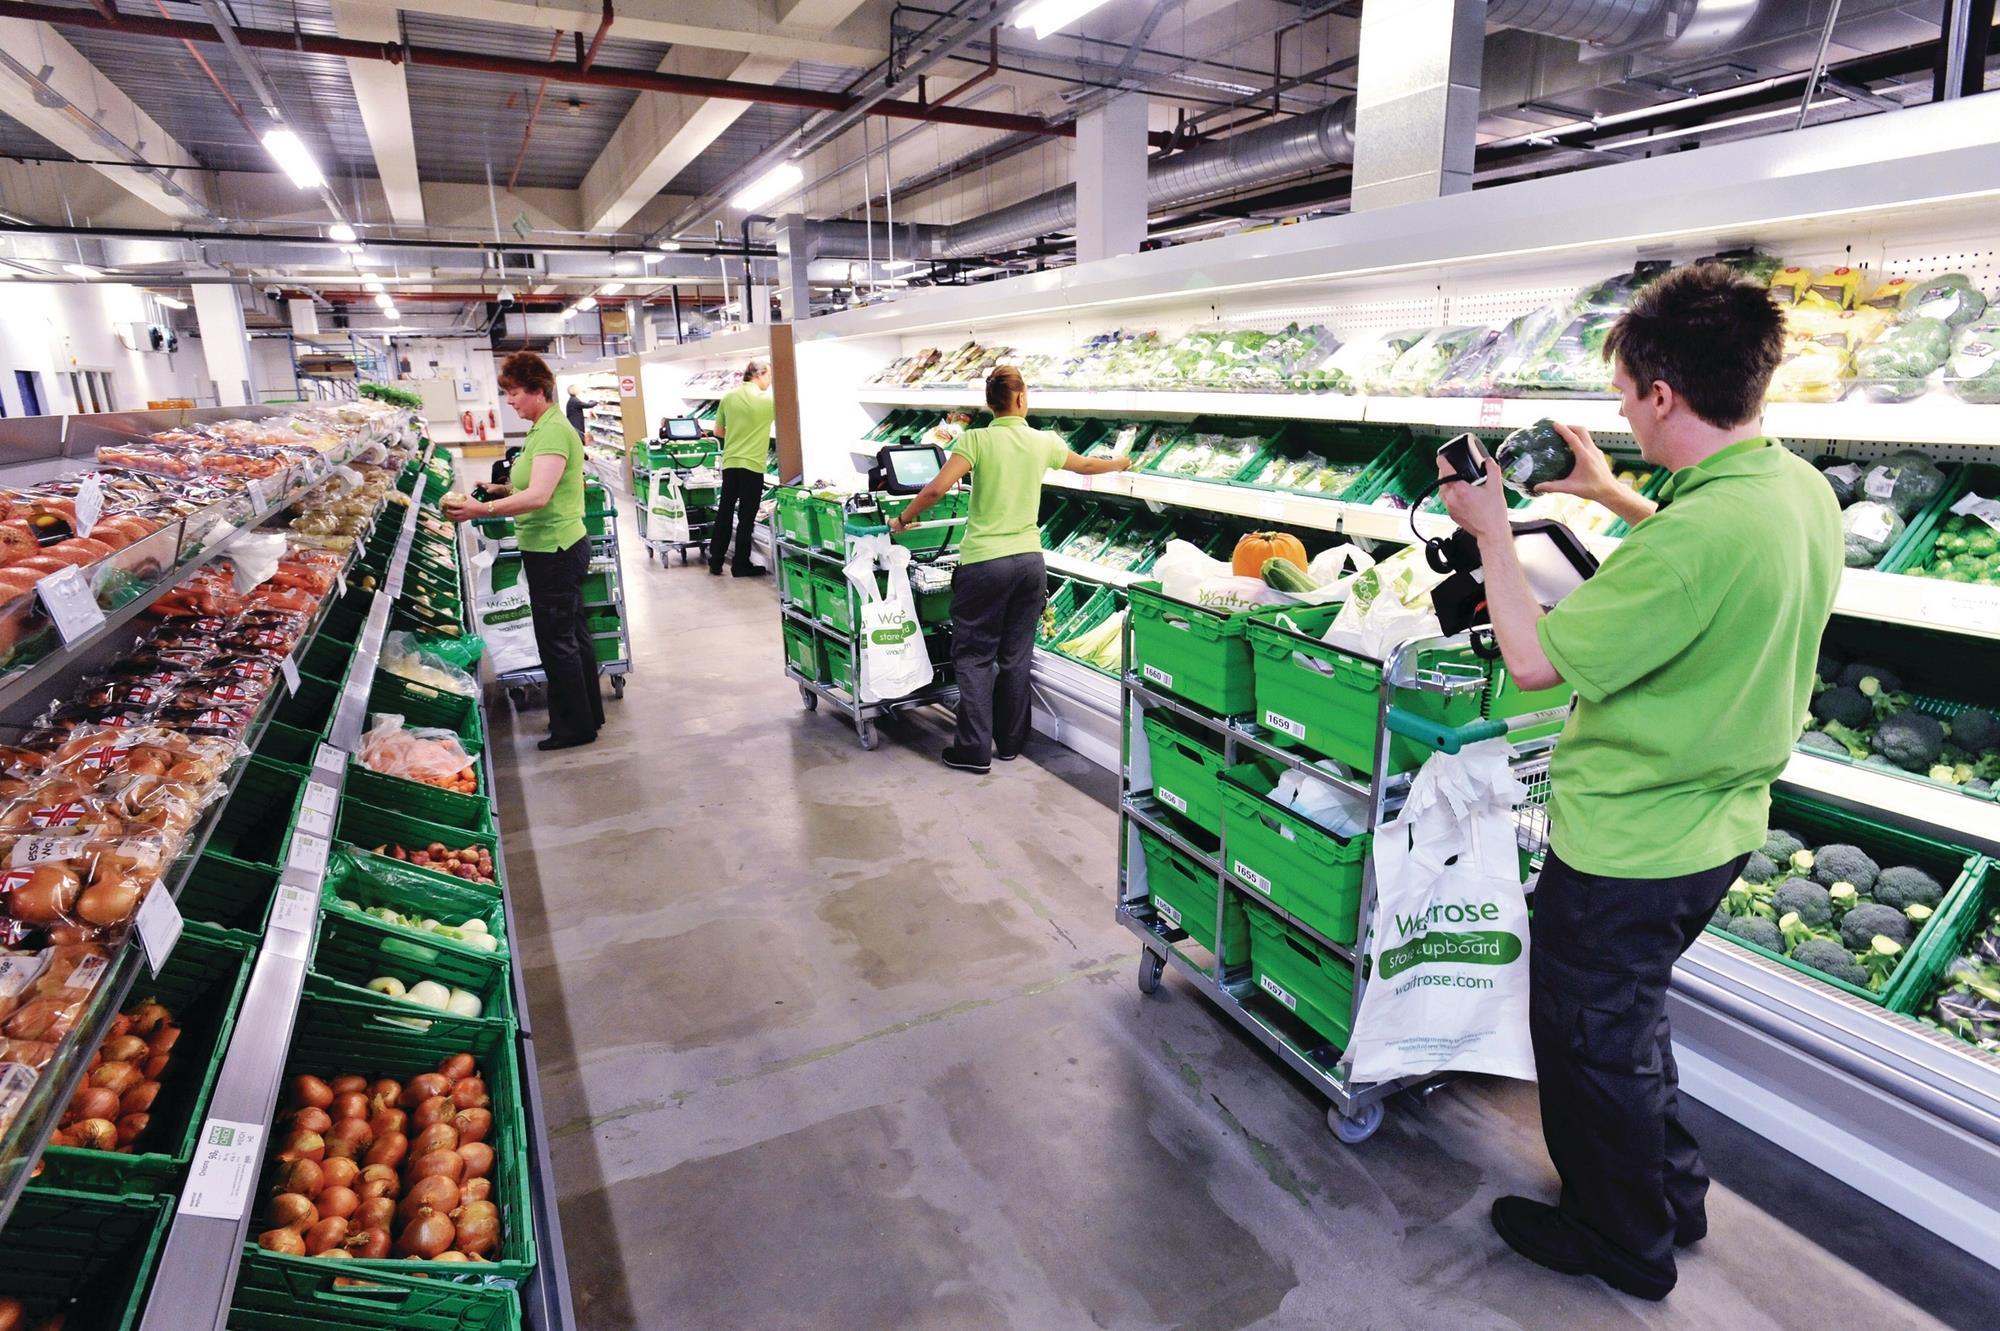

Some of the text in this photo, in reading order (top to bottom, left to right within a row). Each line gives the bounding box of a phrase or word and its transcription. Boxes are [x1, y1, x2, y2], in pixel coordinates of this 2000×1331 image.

[1199, 589, 1262, 611] Waitro
[880, 632, 900, 641] store
[1145, 667, 1162, 680] 1660
[1268, 714, 1290, 731] 1659
[1160, 789, 1176, 804] 1656
[1236, 864, 1257, 884] 1655
[1395, 902, 1499, 938] Warose
[1263, 977, 1283, 996] 1657
[1395, 974, 1494, 996] waitrose.com
[198, 1160, 210, 1176] Onions
